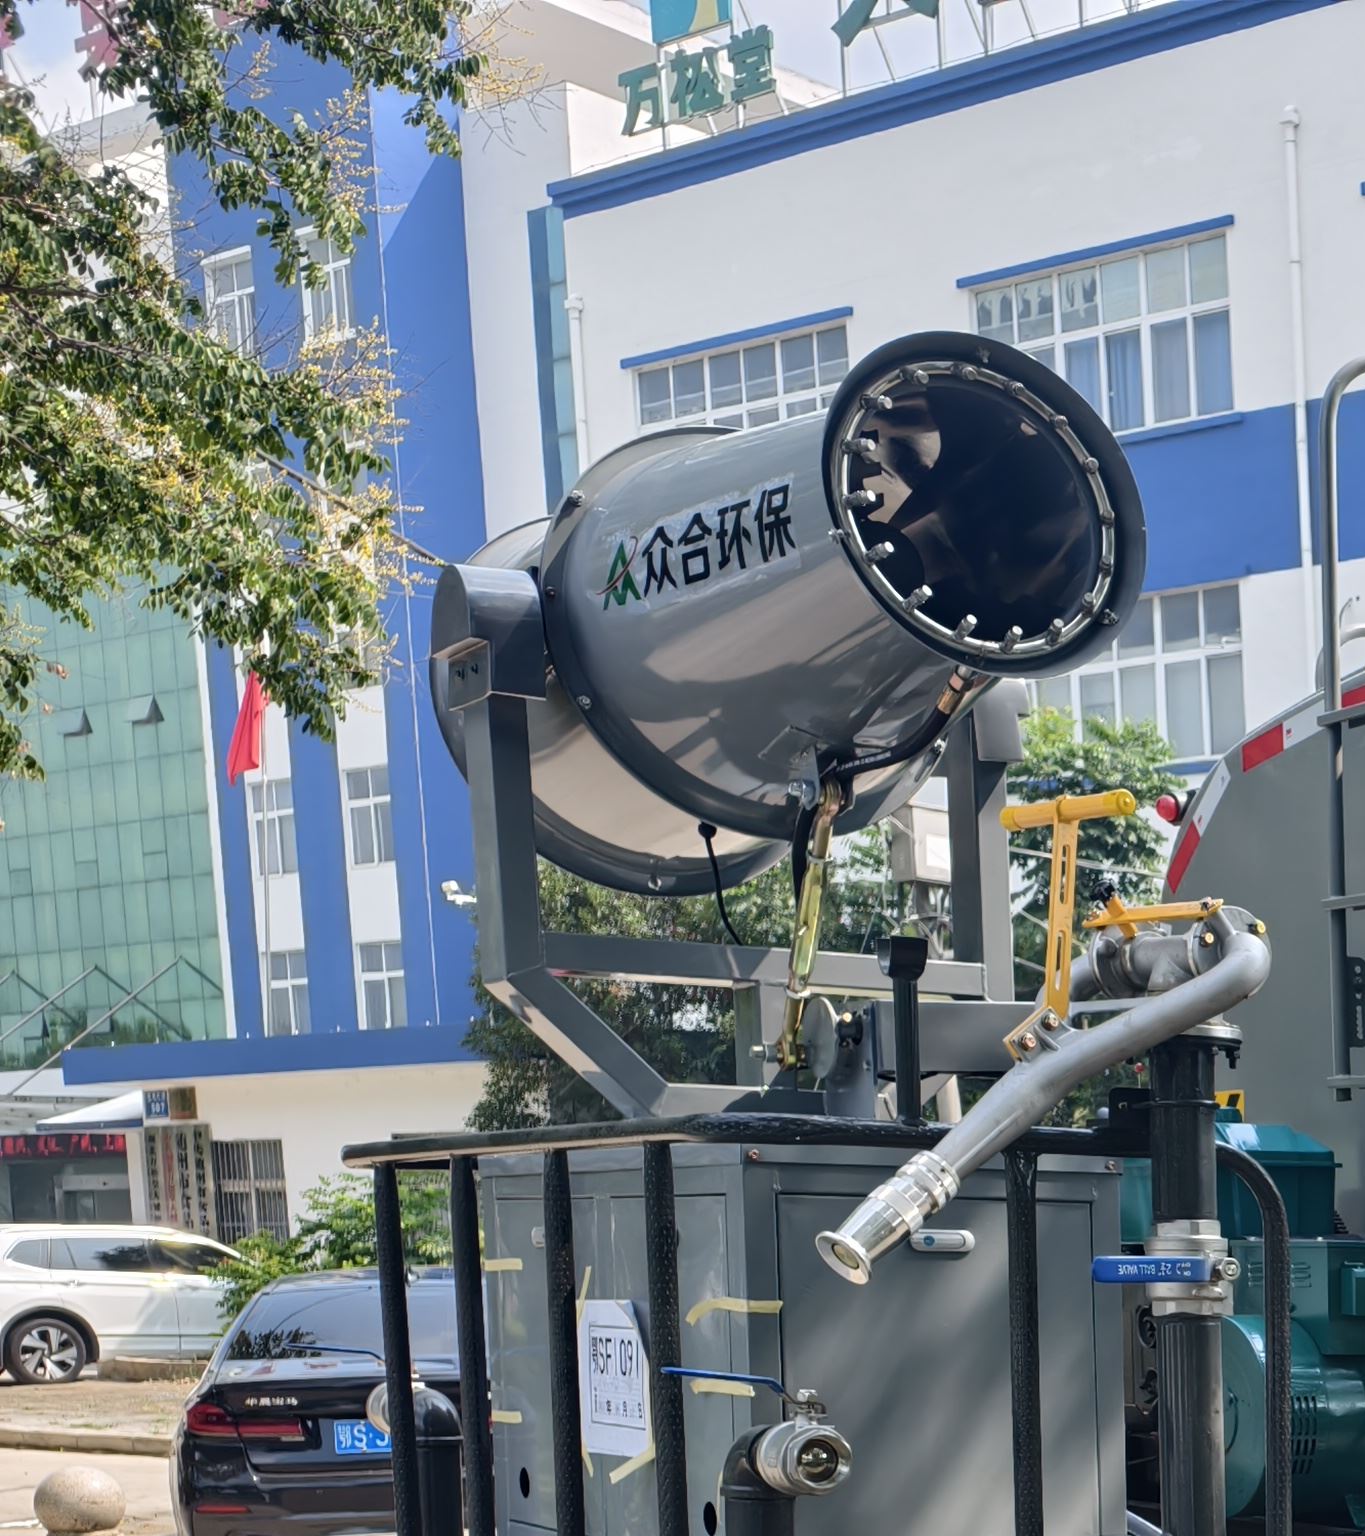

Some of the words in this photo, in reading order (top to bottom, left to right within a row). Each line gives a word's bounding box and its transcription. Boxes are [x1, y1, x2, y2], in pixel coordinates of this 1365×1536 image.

[618, 24, 775, 137] 万松堂
[641, 483, 797, 599] 众合环保
[1117, 1263, 1139, 1276] VALVE
[1139, 1263, 1156, 1276] BALL
